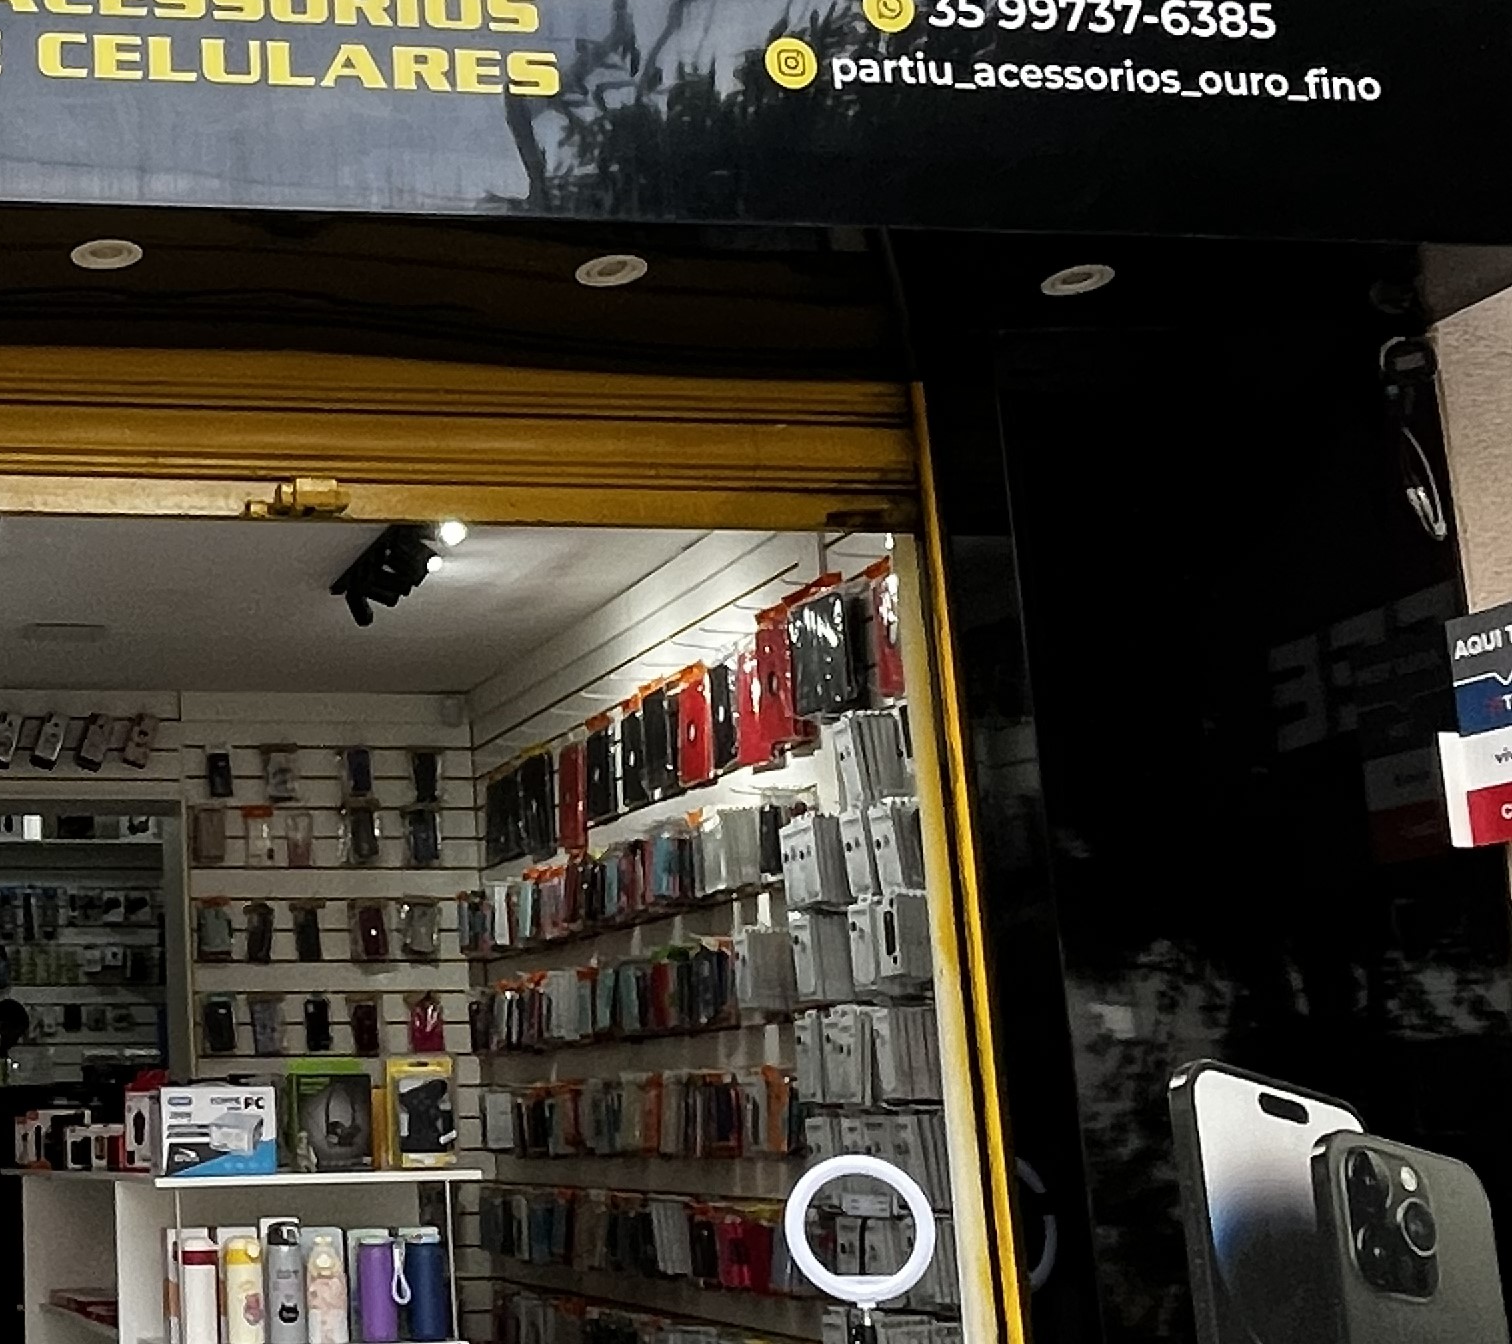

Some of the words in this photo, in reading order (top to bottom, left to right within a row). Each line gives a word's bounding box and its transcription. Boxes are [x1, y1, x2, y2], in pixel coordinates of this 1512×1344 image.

[37, 32, 562, 98] CELULARES
[830, 50, 1382, 103] partiu_acessorios_ouro_fino
[1454, 629, 1503, 660] AQUI
